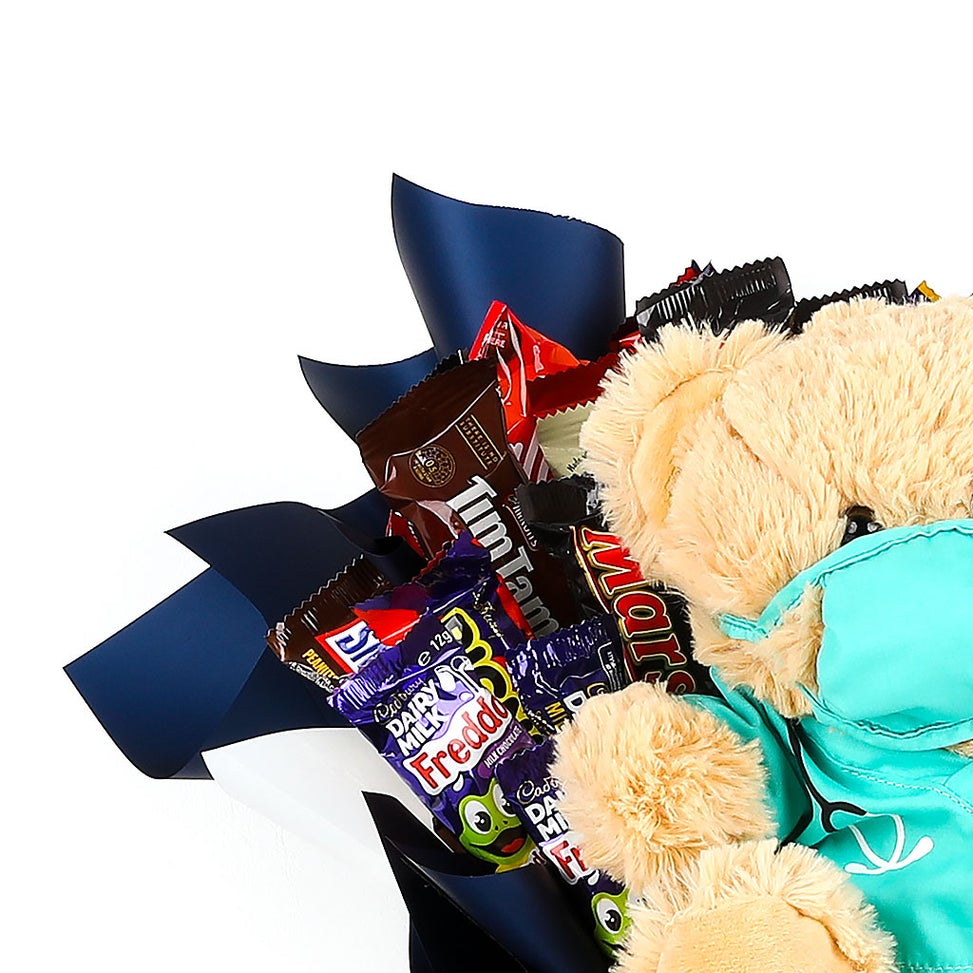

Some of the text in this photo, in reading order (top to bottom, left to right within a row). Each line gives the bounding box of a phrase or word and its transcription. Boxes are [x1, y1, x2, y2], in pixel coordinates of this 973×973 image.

[580, 526, 697, 695] Mars
[429, 629, 453, 651] 12g
[386, 678, 441, 739] DAIRY
[396, 701, 449, 757] MILK
[537, 811, 570, 842] MI
